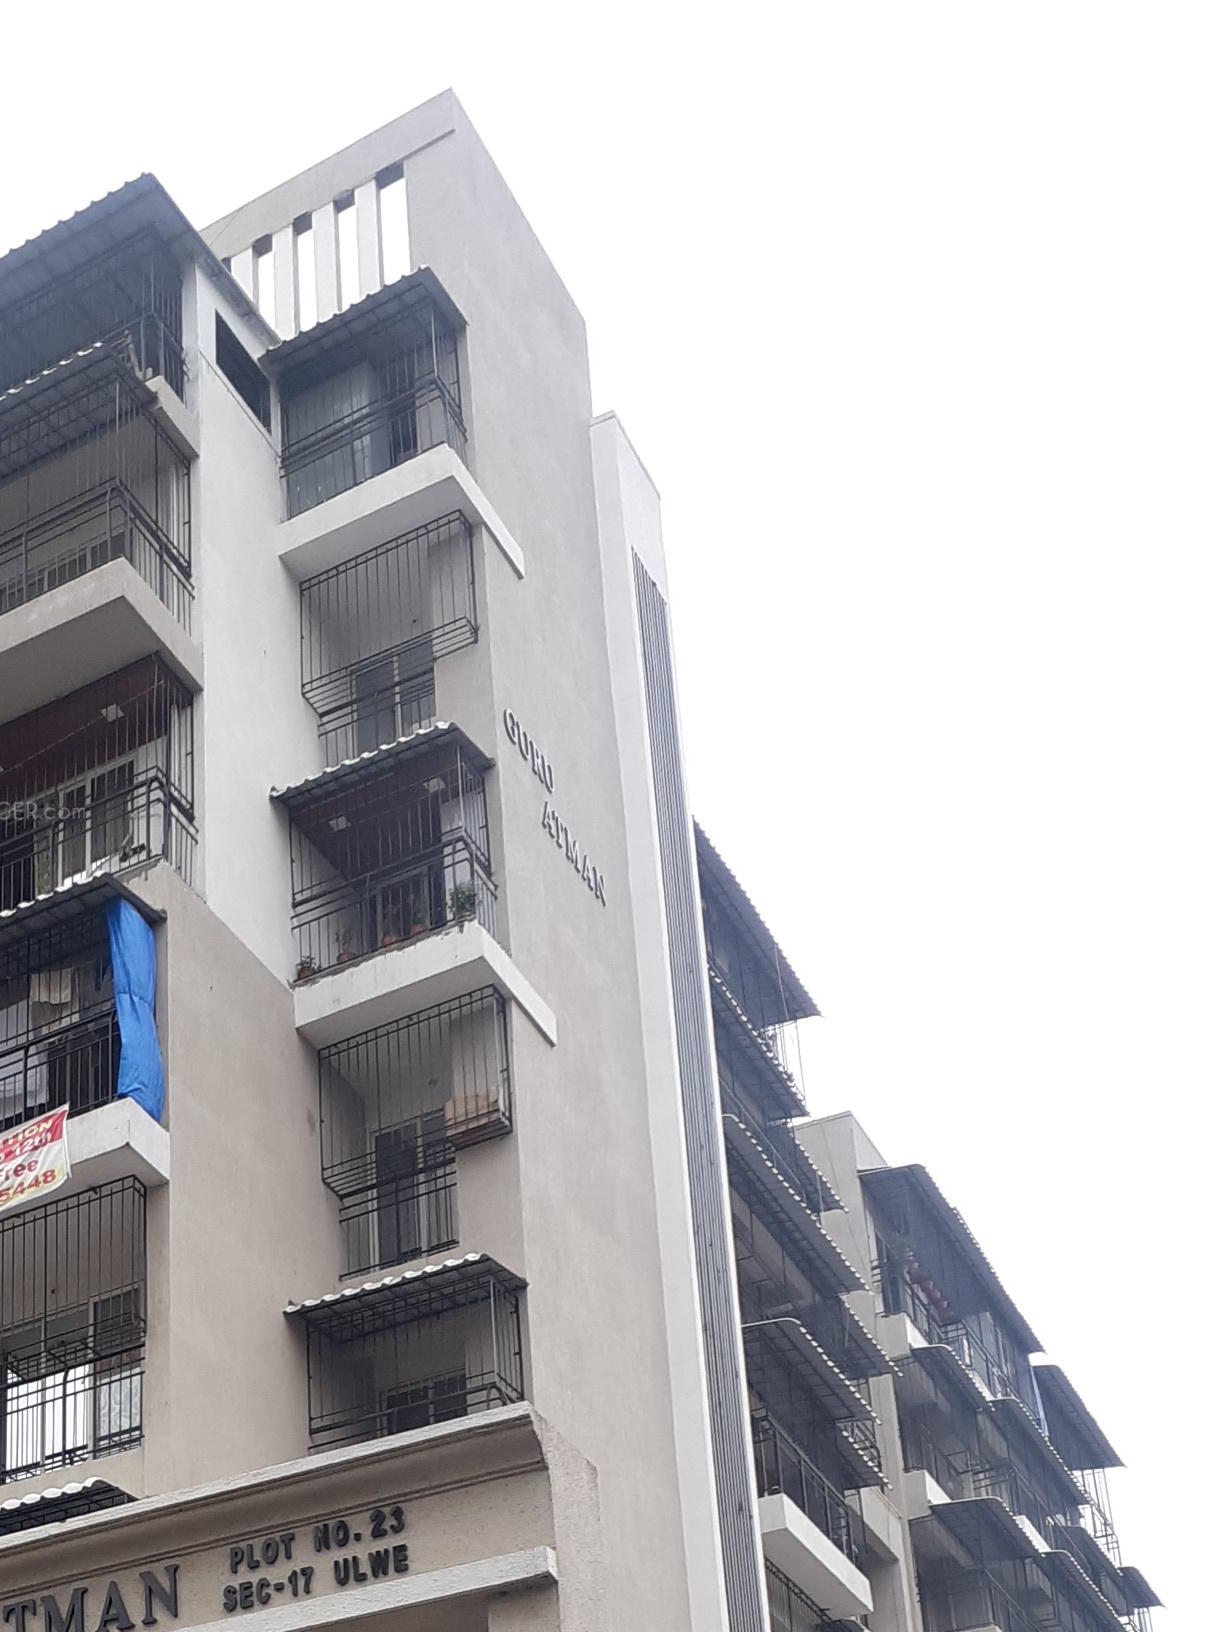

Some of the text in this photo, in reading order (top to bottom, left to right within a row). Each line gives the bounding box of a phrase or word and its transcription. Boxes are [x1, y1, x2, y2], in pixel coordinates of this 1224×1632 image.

[230, 1505, 406, 1575] PLOT NO. 23
[223, 1543, 410, 1613] SEC-17 ULWE
